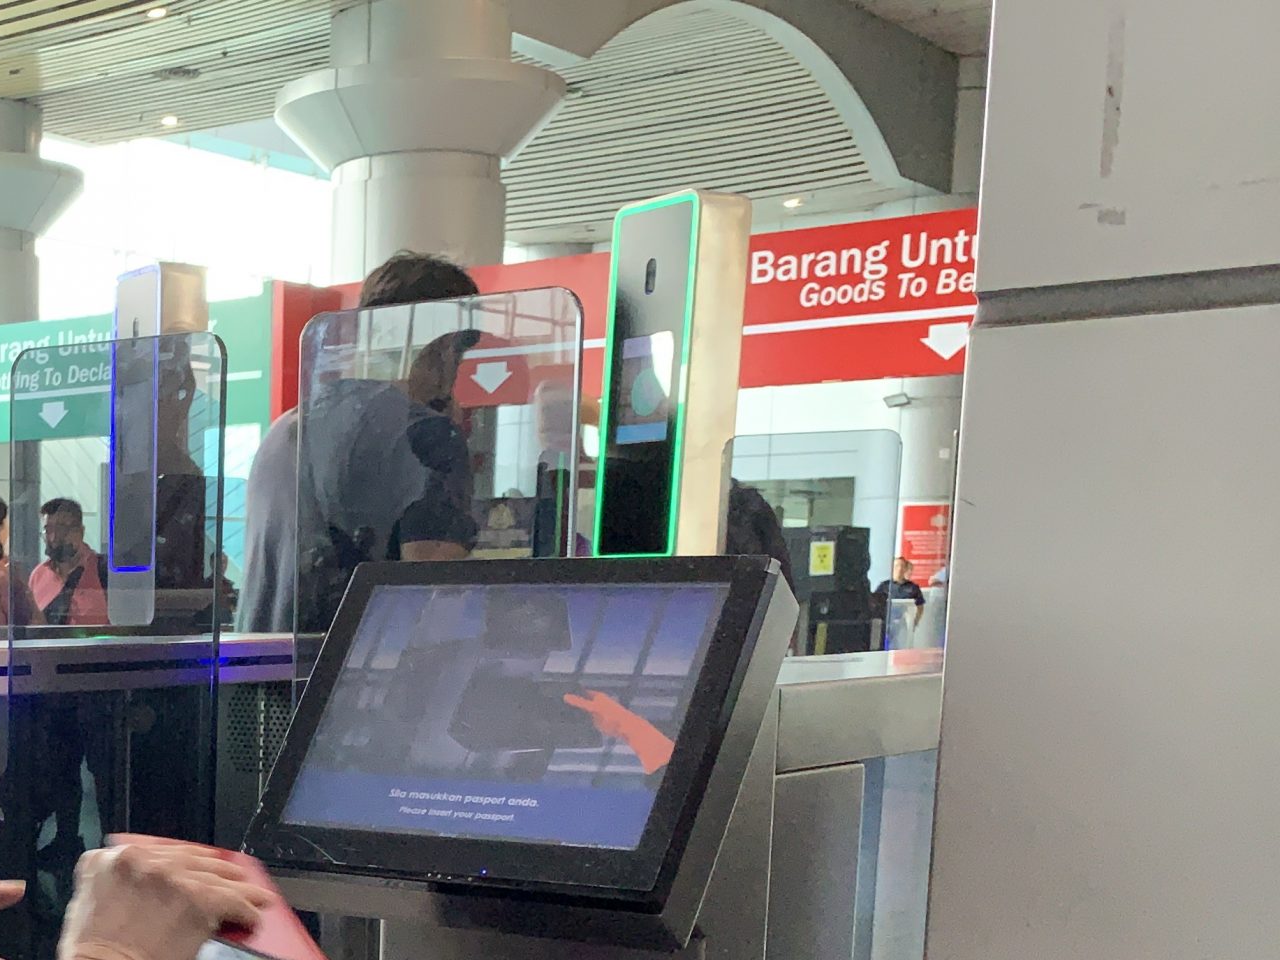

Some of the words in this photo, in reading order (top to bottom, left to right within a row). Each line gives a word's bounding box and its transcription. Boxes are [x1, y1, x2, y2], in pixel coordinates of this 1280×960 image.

[750, 240, 890, 285] Barang
[900, 229, 978, 268] Unt
[799, 279, 886, 308] Goods
[897, 272, 928, 299] To
[935, 268, 976, 295] Be
[57, 328, 111, 357] Untu
[43, 367, 62, 387] To
[66, 362, 112, 385] Decla
[388, 788, 407, 799] Sila
[408, 790, 462, 803] masukkan
[463, 795, 506, 806] pasport
[399, 806, 427, 815] Please
[452, 811, 473, 819] your
